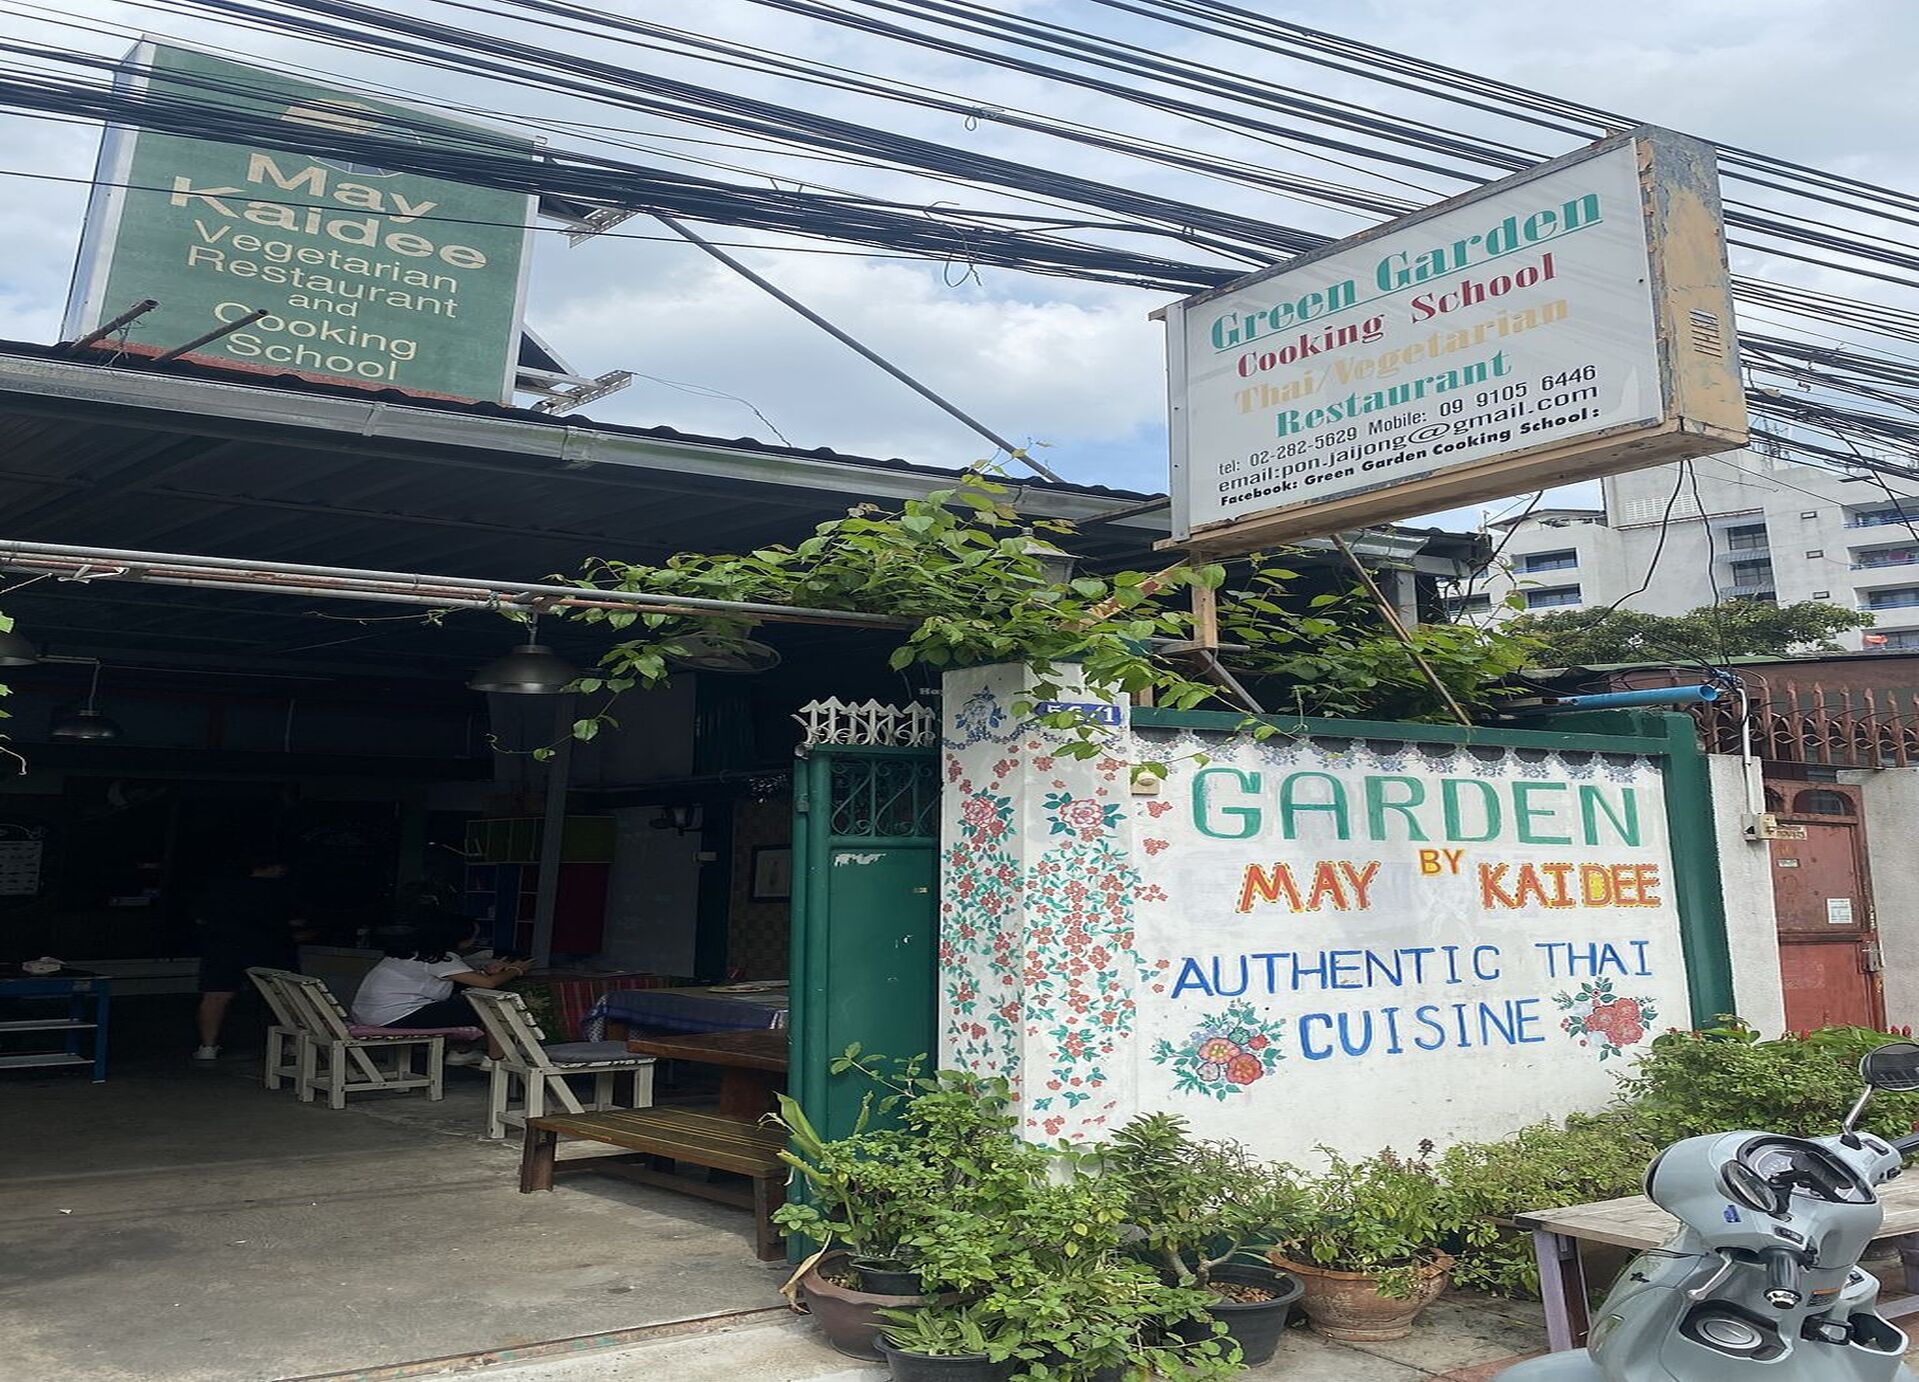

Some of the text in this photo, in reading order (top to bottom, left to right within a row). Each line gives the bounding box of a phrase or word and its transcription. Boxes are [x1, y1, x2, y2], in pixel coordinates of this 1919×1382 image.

[171, 176, 487, 270] Kaidee
[247, 152, 438, 224] May
[188, 245, 457, 318] Restaurant
[194, 219, 458, 294] Vegetarian
[1212, 193, 1602, 350] Green Garden
[213, 302, 418, 361] Cooking
[288, 294, 358, 318] and
[1238, 253, 1557, 378] Cooking School
[225, 333, 397, 381] School
[1219, 364, 1597, 476] tel: 02-282-5629 Mobile: 09 9105 6446
[1276, 350, 1512, 438] Restaurant
[1220, 481, 1299, 507] Facebook:
[1304, 467, 1355, 487] Green
[1362, 449, 1427, 472] Garden
[1432, 430, 1512, 456] Cooking
[1191, 767, 1642, 847] GARDEN
[1235, 860, 1662, 914] MAY KAIDEE
[1420, 849, 1465, 877] BY
[1171, 939, 1653, 1000] AUTHENTIC THAI
[1300, 998, 1546, 1061] CUISINE
